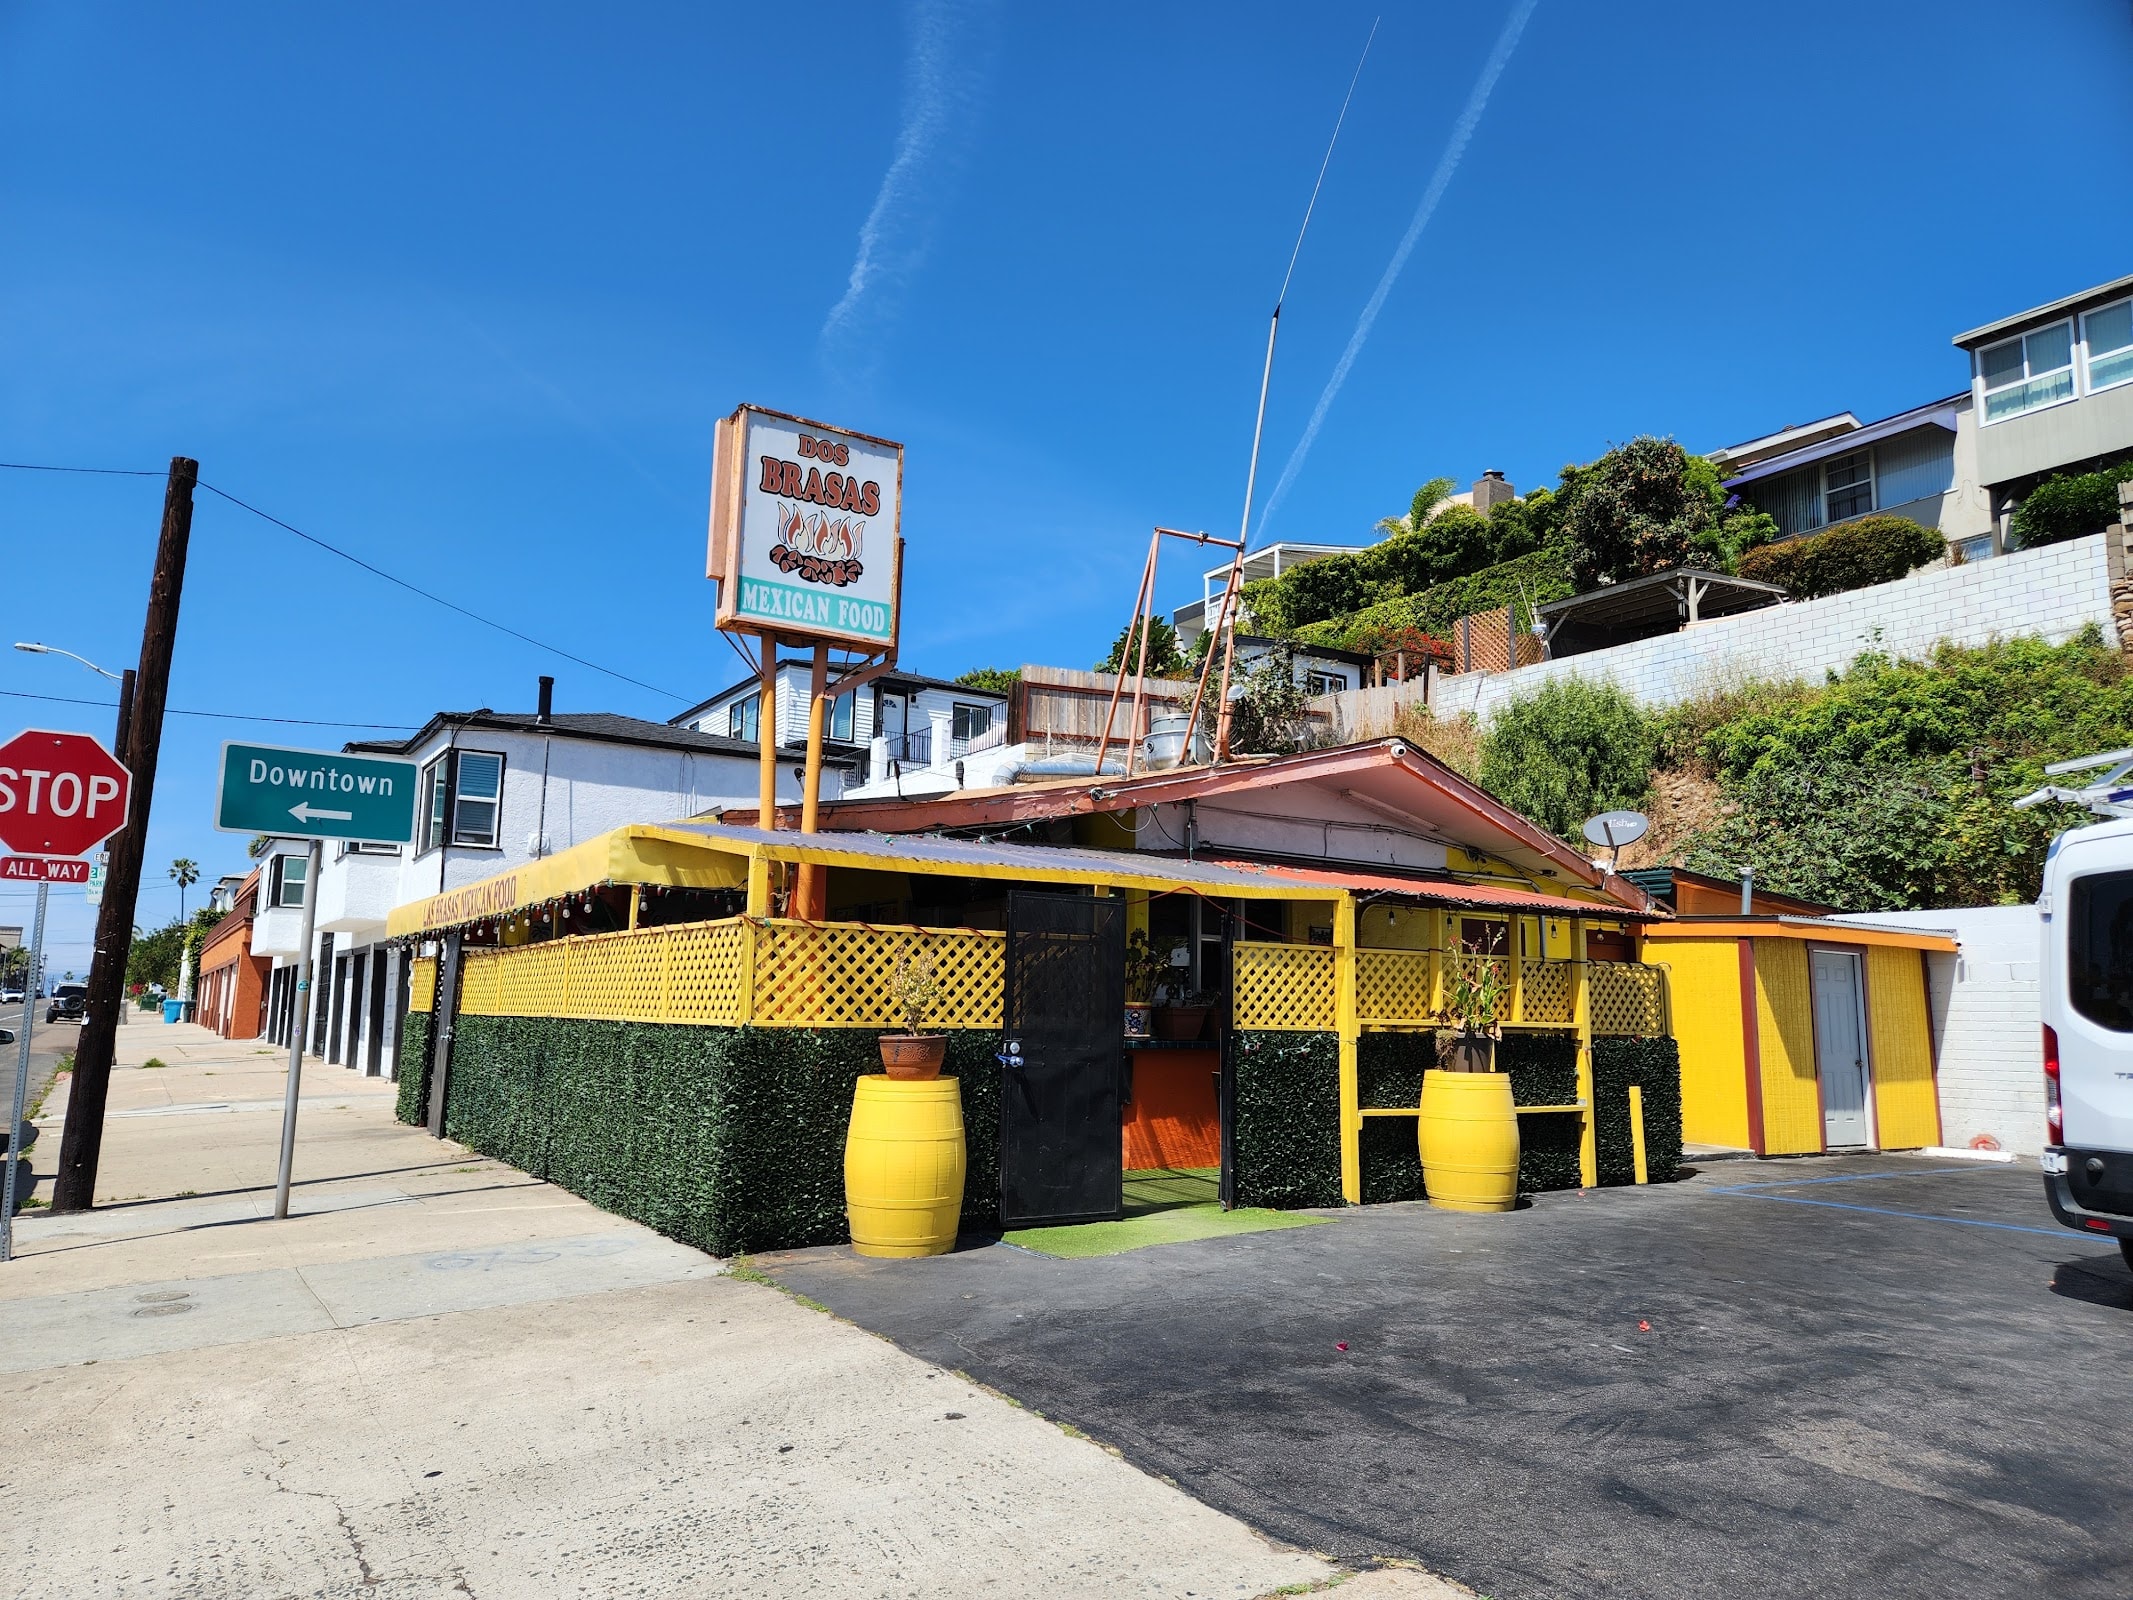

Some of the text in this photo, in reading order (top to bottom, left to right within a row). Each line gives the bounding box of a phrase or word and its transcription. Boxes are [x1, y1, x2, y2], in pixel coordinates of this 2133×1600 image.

[798, 434, 850, 467] DOS
[760, 456, 880, 516] BRASAS
[742, 582, 886, 633] MEXICAN FOOD
[0, 766, 119, 819] STOP
[249, 758, 394, 797] Downtown
[6, 860, 82, 879] ALL WAY
[423, 875, 517, 927] LAS BRASAS MEXICAN FOOD
